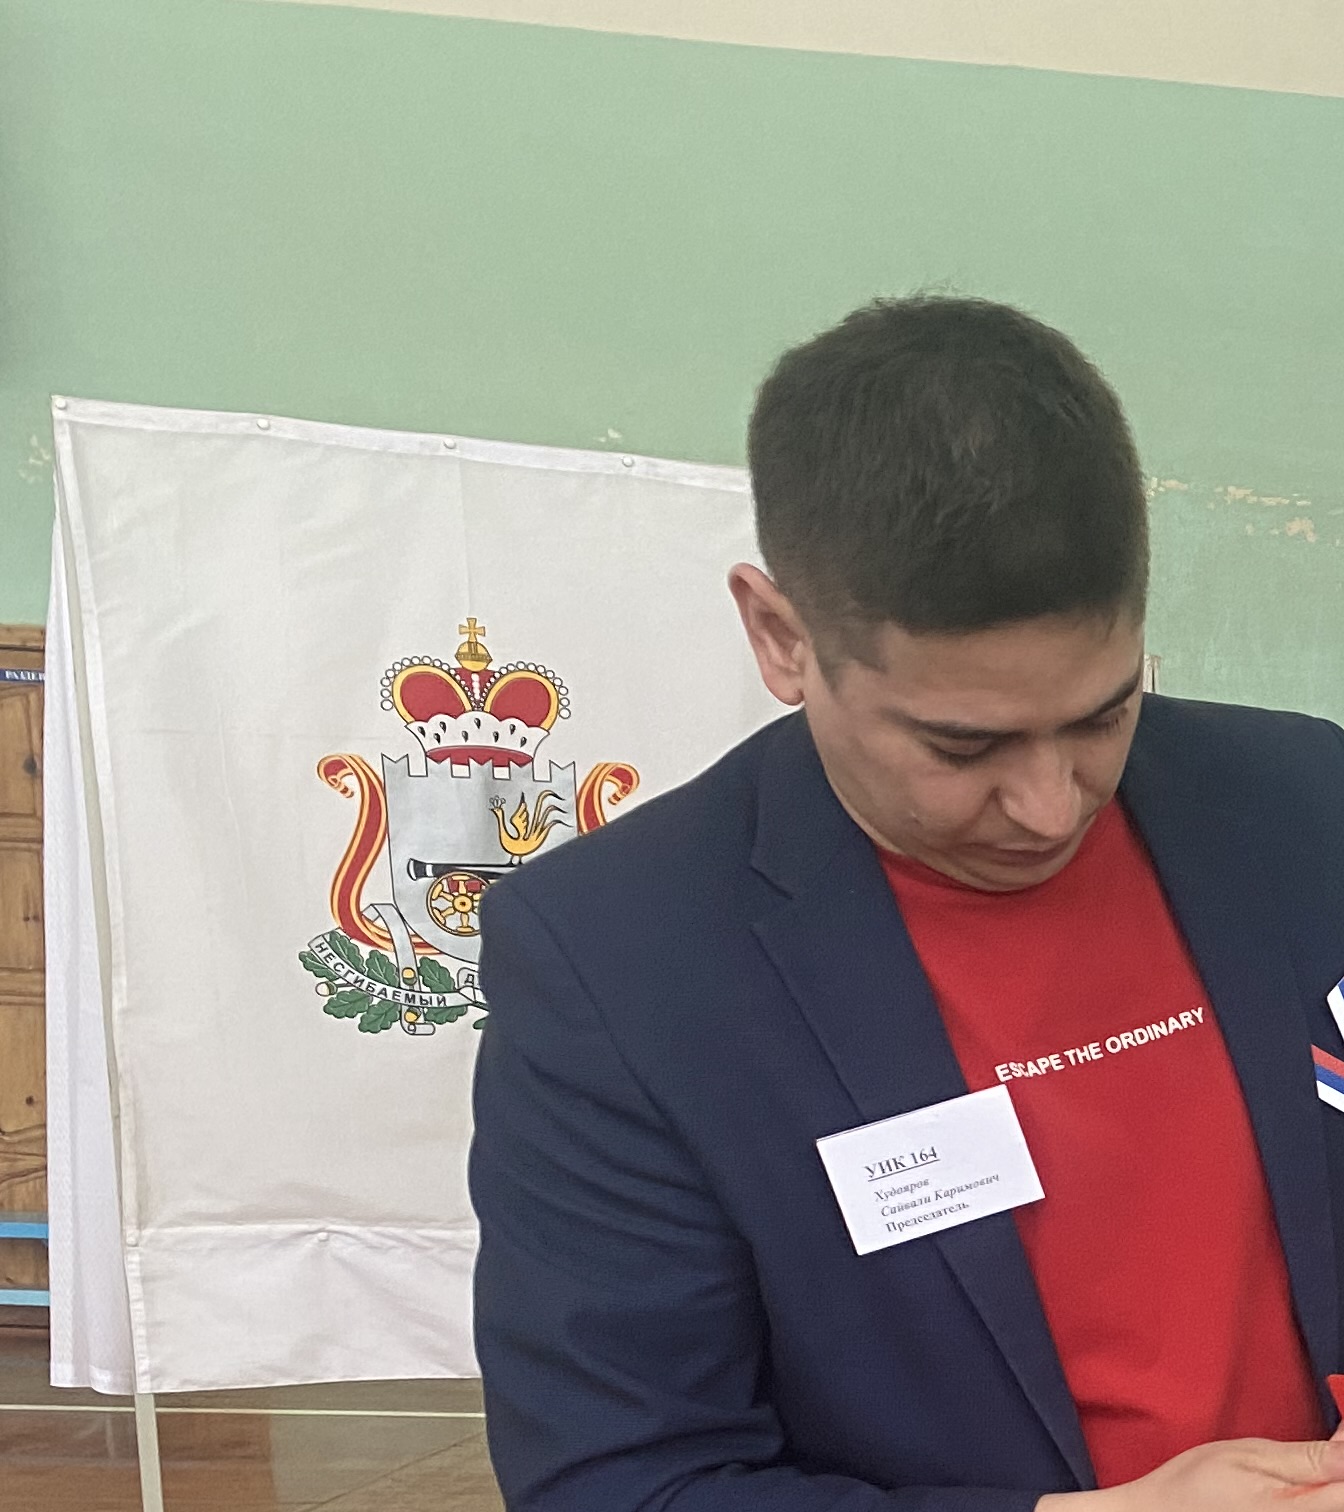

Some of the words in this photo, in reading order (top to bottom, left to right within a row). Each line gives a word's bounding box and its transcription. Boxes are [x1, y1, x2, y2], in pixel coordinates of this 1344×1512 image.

[994, 1053, 1066, 1082] ESCAPE
[1063, 1042, 1104, 1067] THE
[1105, 1006, 1204, 1054] ORDINARY
[864, 1155, 907, 1179] УИК
[910, 1146, 938, 1165] 164
[934, 1173, 1000, 1202] Каримович
[885, 1201, 970, 1233] Председатель
